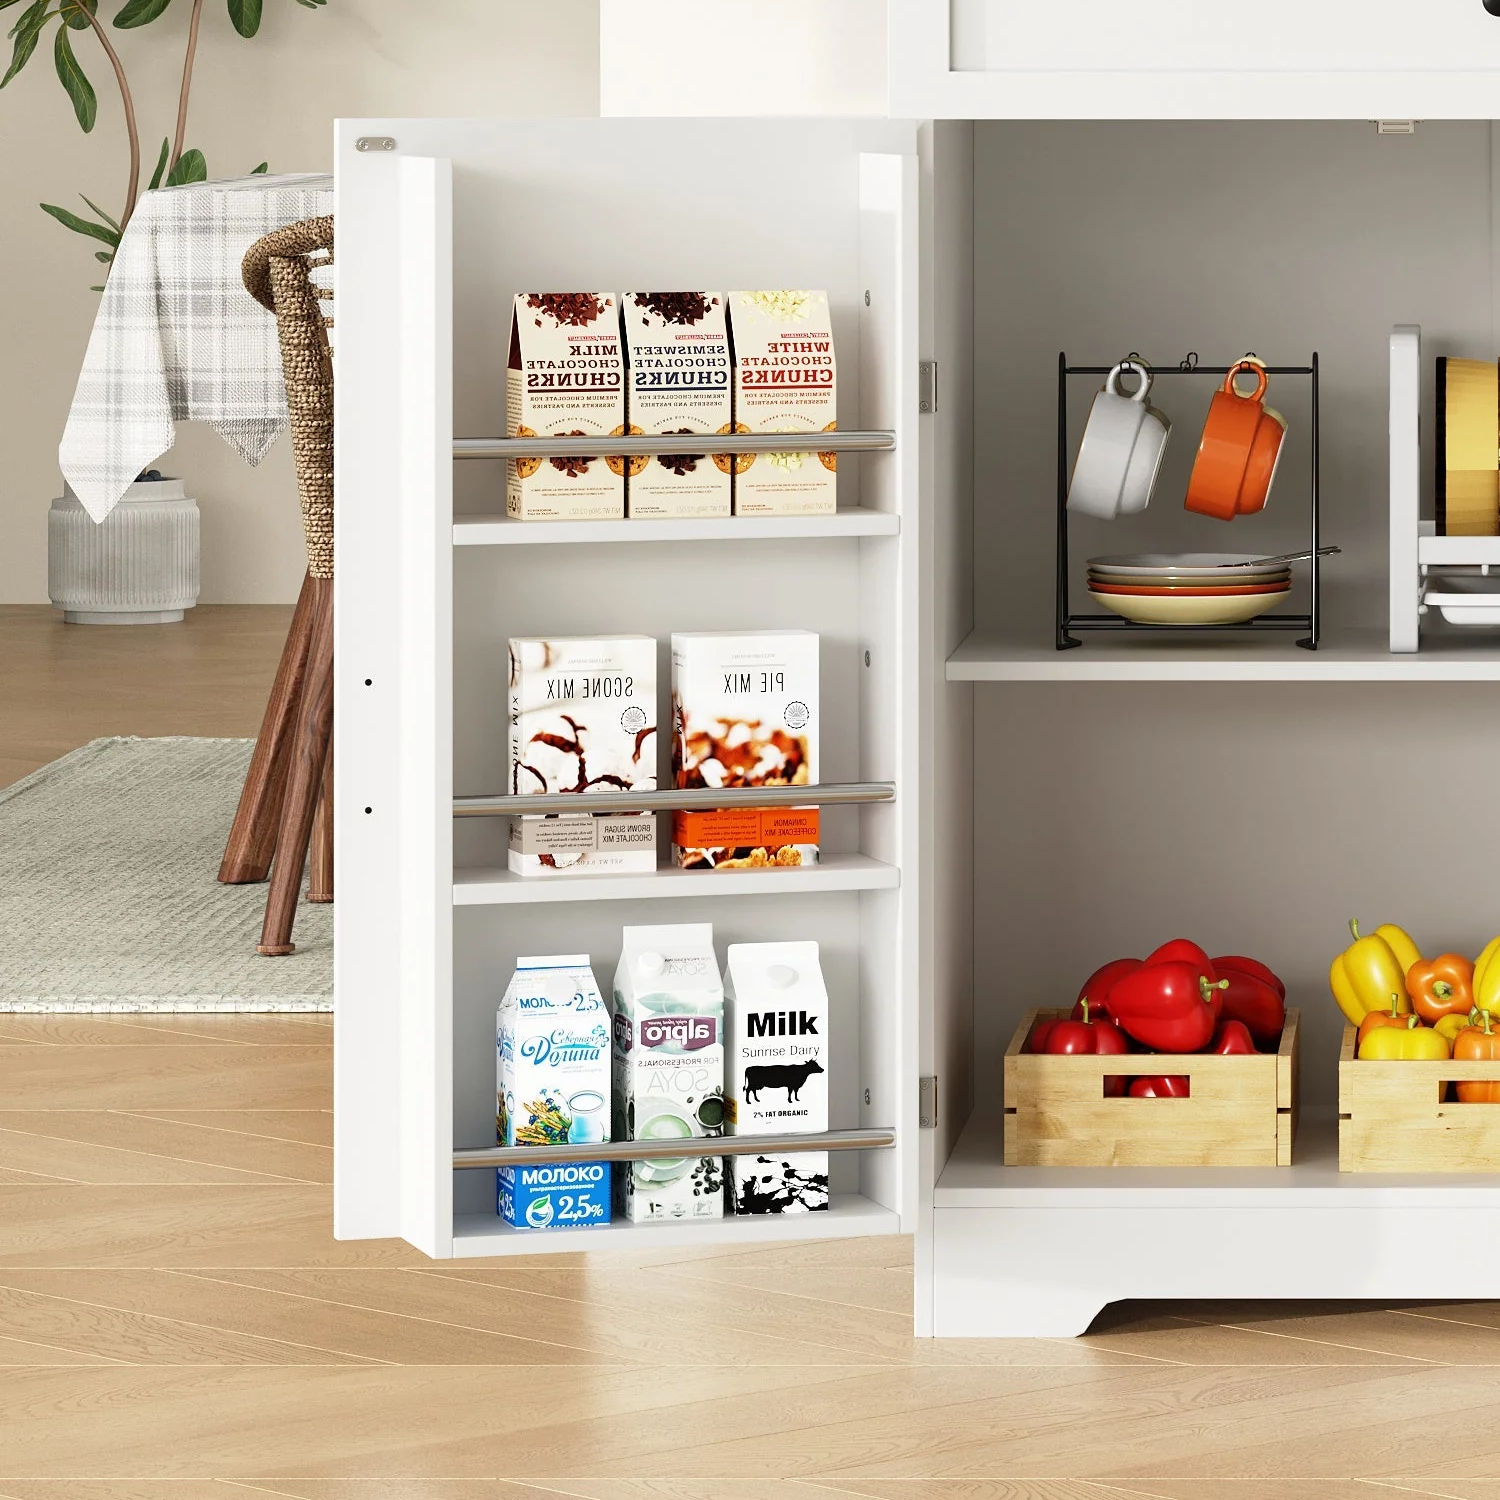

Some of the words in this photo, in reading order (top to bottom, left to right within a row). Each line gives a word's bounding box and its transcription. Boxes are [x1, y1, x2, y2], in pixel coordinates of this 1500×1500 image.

[520, 998, 572, 1008] МОЛ
[748, 1011, 818, 1038] Milk
[521, 1036, 600, 1067] Долина
[742, 1048, 786, 1058] Sunrise
[790, 1046, 820, 1056] Dairy
[522, 1166, 604, 1185] МОЛОКО
[558, 1194, 604, 1221] 2,5%
